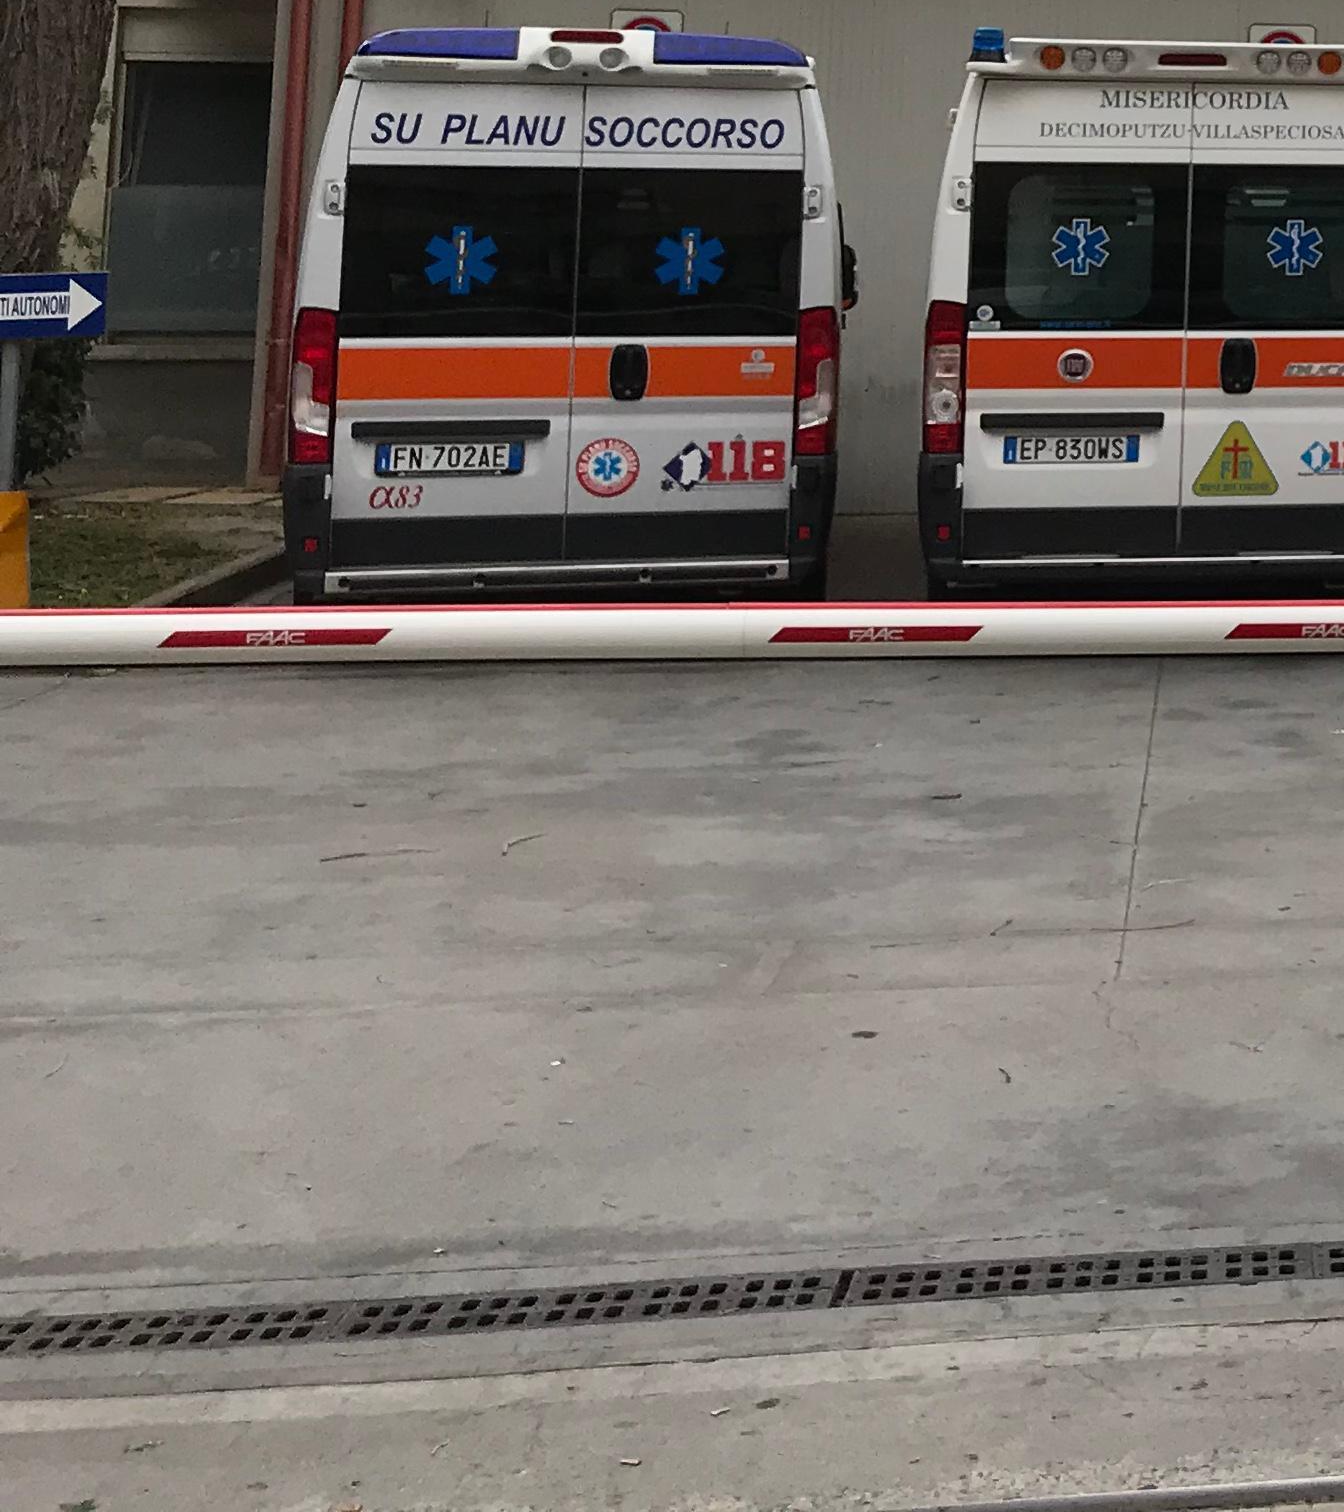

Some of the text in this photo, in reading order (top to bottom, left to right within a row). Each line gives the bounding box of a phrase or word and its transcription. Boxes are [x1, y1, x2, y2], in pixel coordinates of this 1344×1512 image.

[1099, 89, 1290, 111] MISERICORDIA
[370, 112, 786, 150] SU PLANU SOCCORSO
[11, 295, 70, 316] AUTONOMI
[707, 440, 786, 482] 118
[247, 630, 306, 646] FAAC
[849, 626, 904, 642] FAAC
